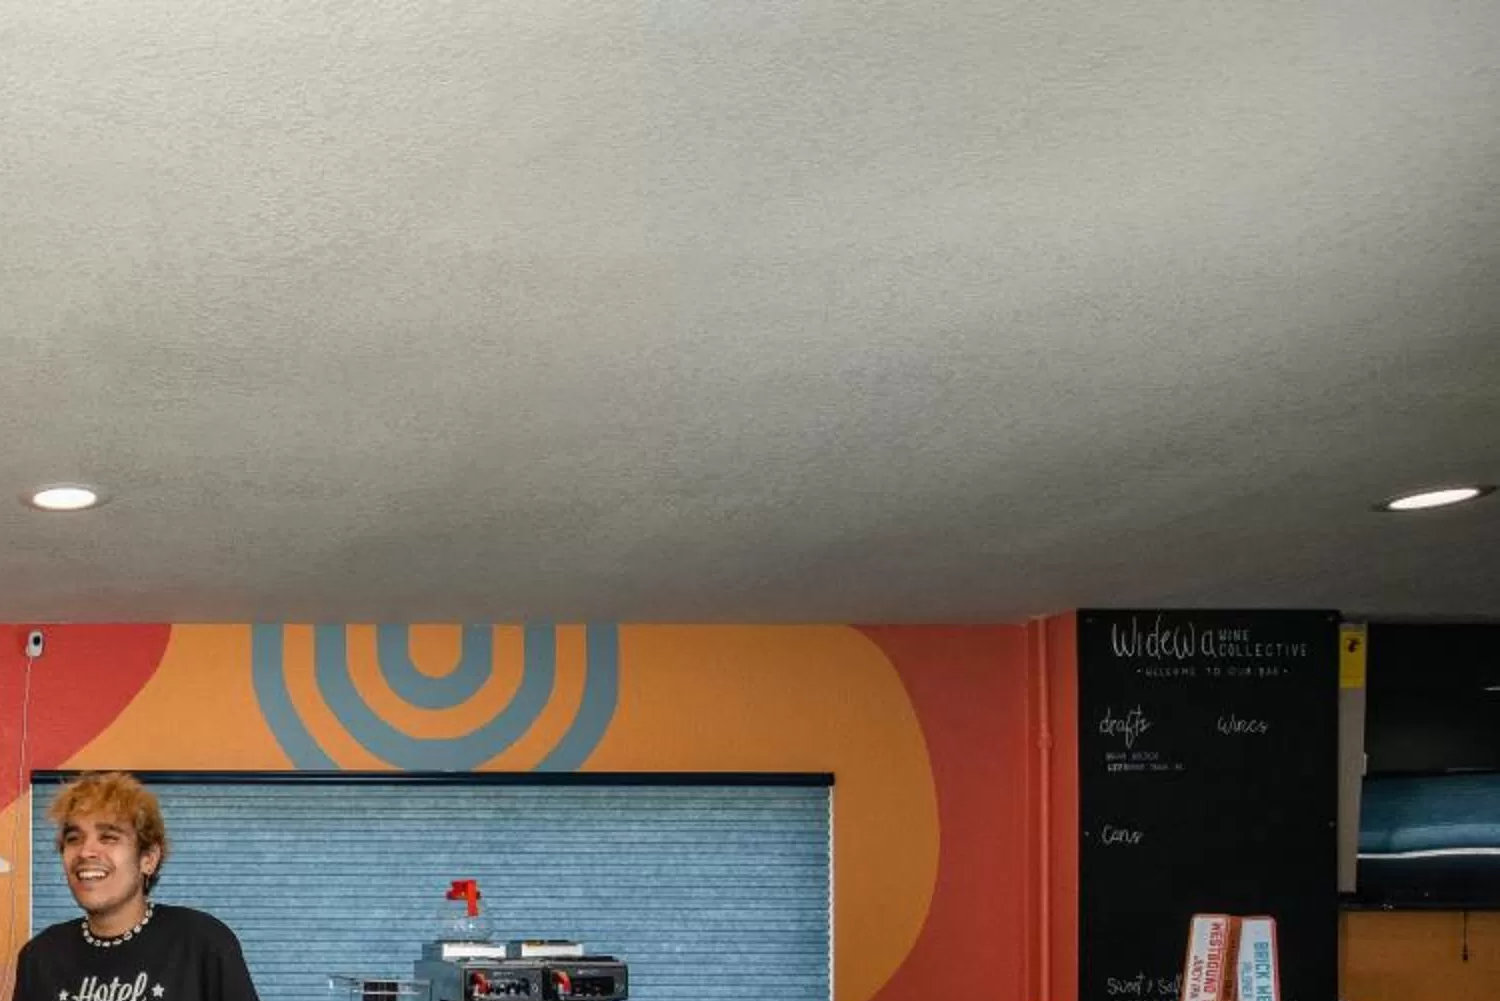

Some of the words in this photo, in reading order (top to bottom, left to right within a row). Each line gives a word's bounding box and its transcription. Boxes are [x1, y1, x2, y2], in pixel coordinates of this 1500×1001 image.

[1219, 643, 1308, 657] COLLECTIVE
[1204, 923, 1222, 993] WESTBOUND
[1254, 941, 1270, 979] BRICK
